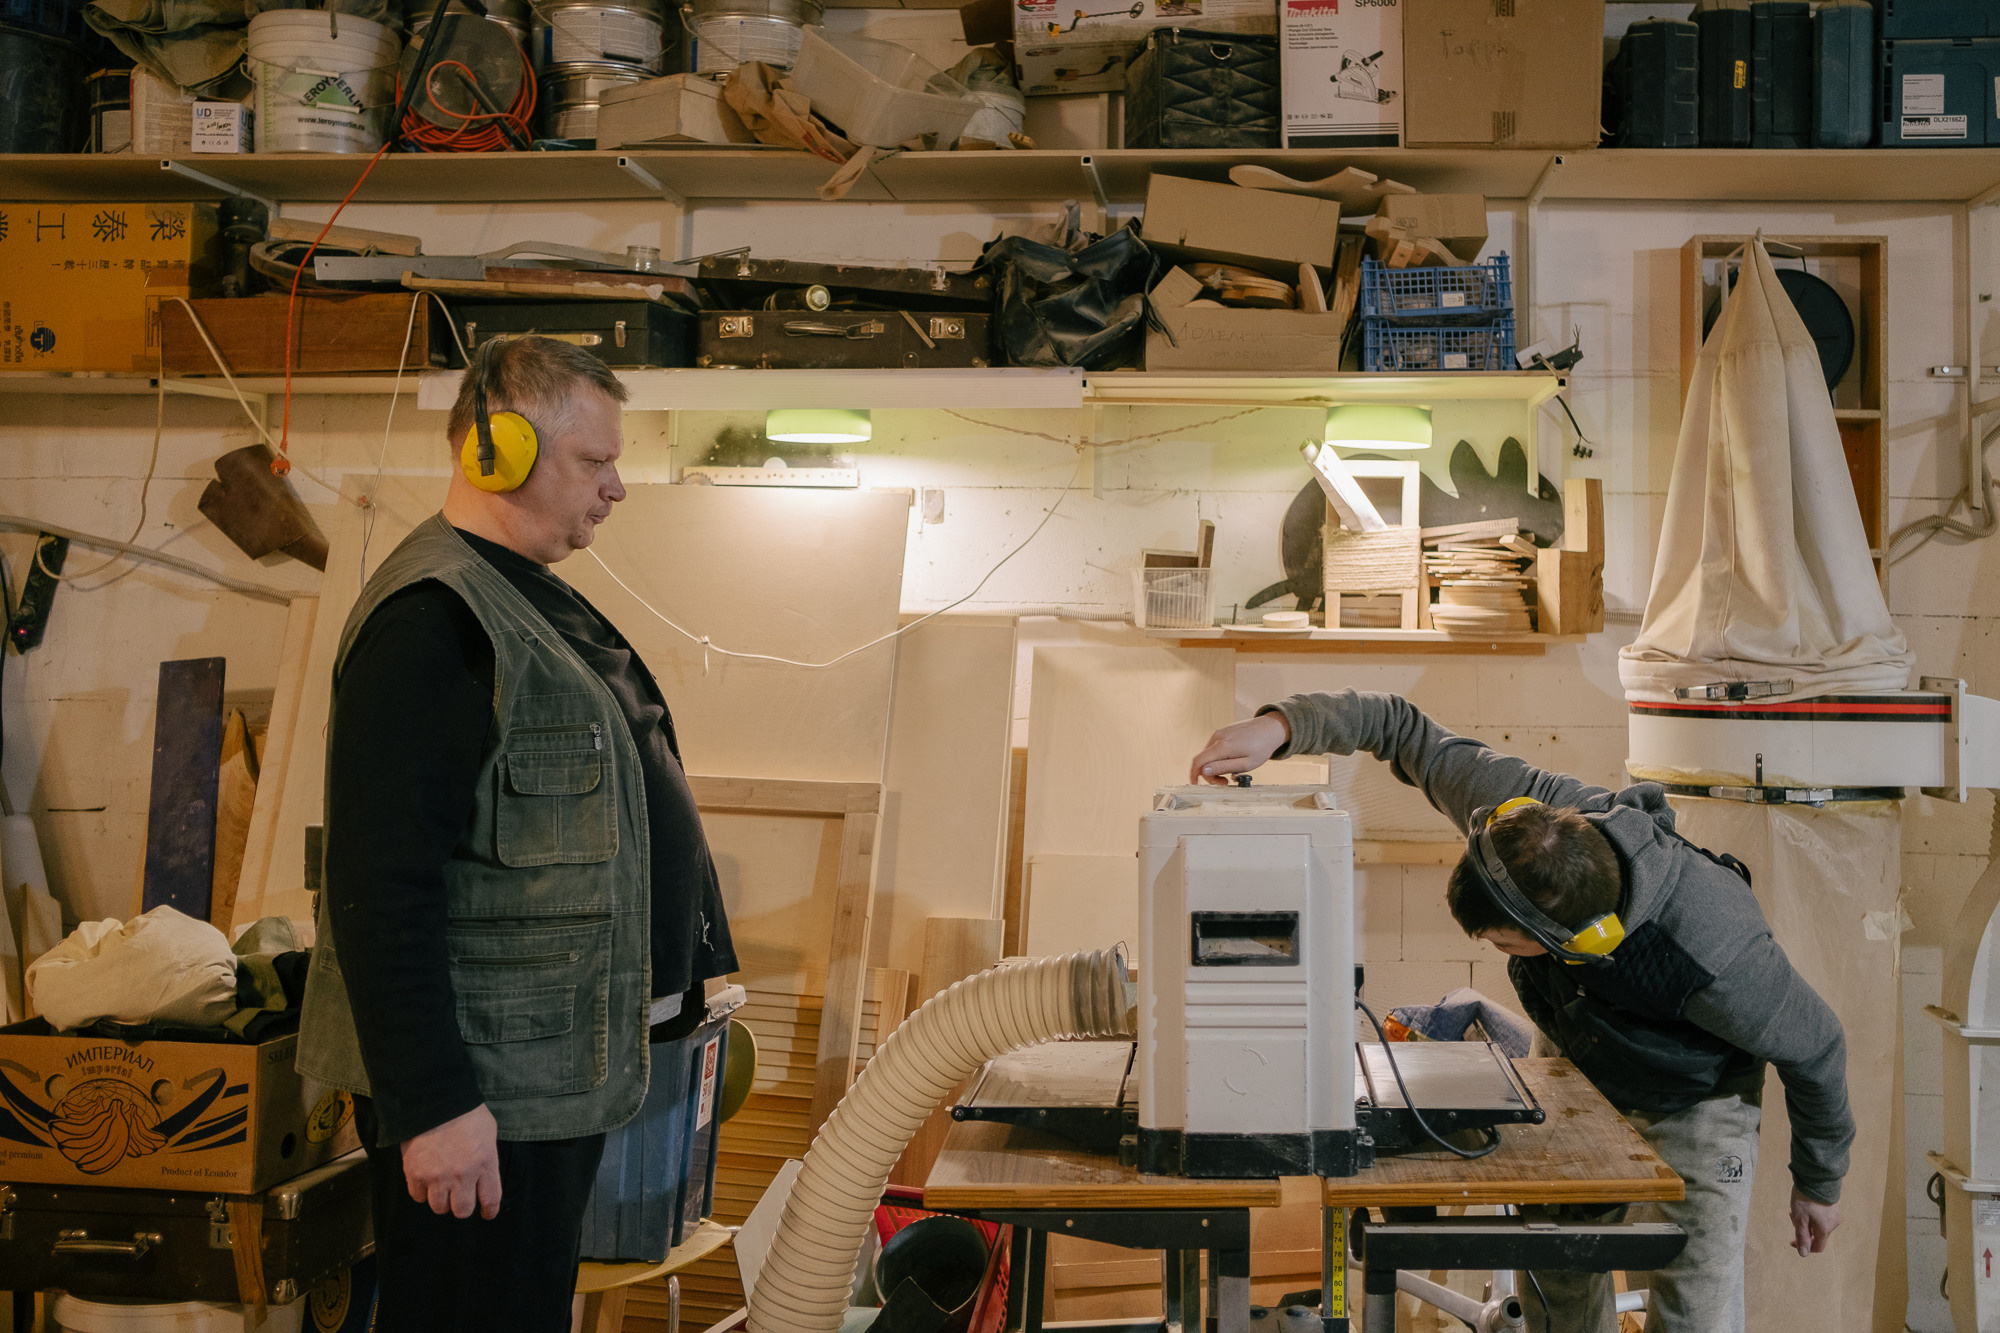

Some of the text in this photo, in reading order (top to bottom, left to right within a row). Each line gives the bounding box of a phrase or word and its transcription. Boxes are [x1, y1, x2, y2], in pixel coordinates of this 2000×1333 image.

[196, 108, 212, 117] UD
[298, 116, 366, 131] www.leroymerlin.ru
[0, 210, 186, 243] 榮泰工
[65, 1046, 155, 1073] ИМПЕРИАЛ
[82, 1063, 133, 1078] imperial
[9, 1150, 43, 1160] premium
[161, 1166, 238, 1178] Product of Ecuador
